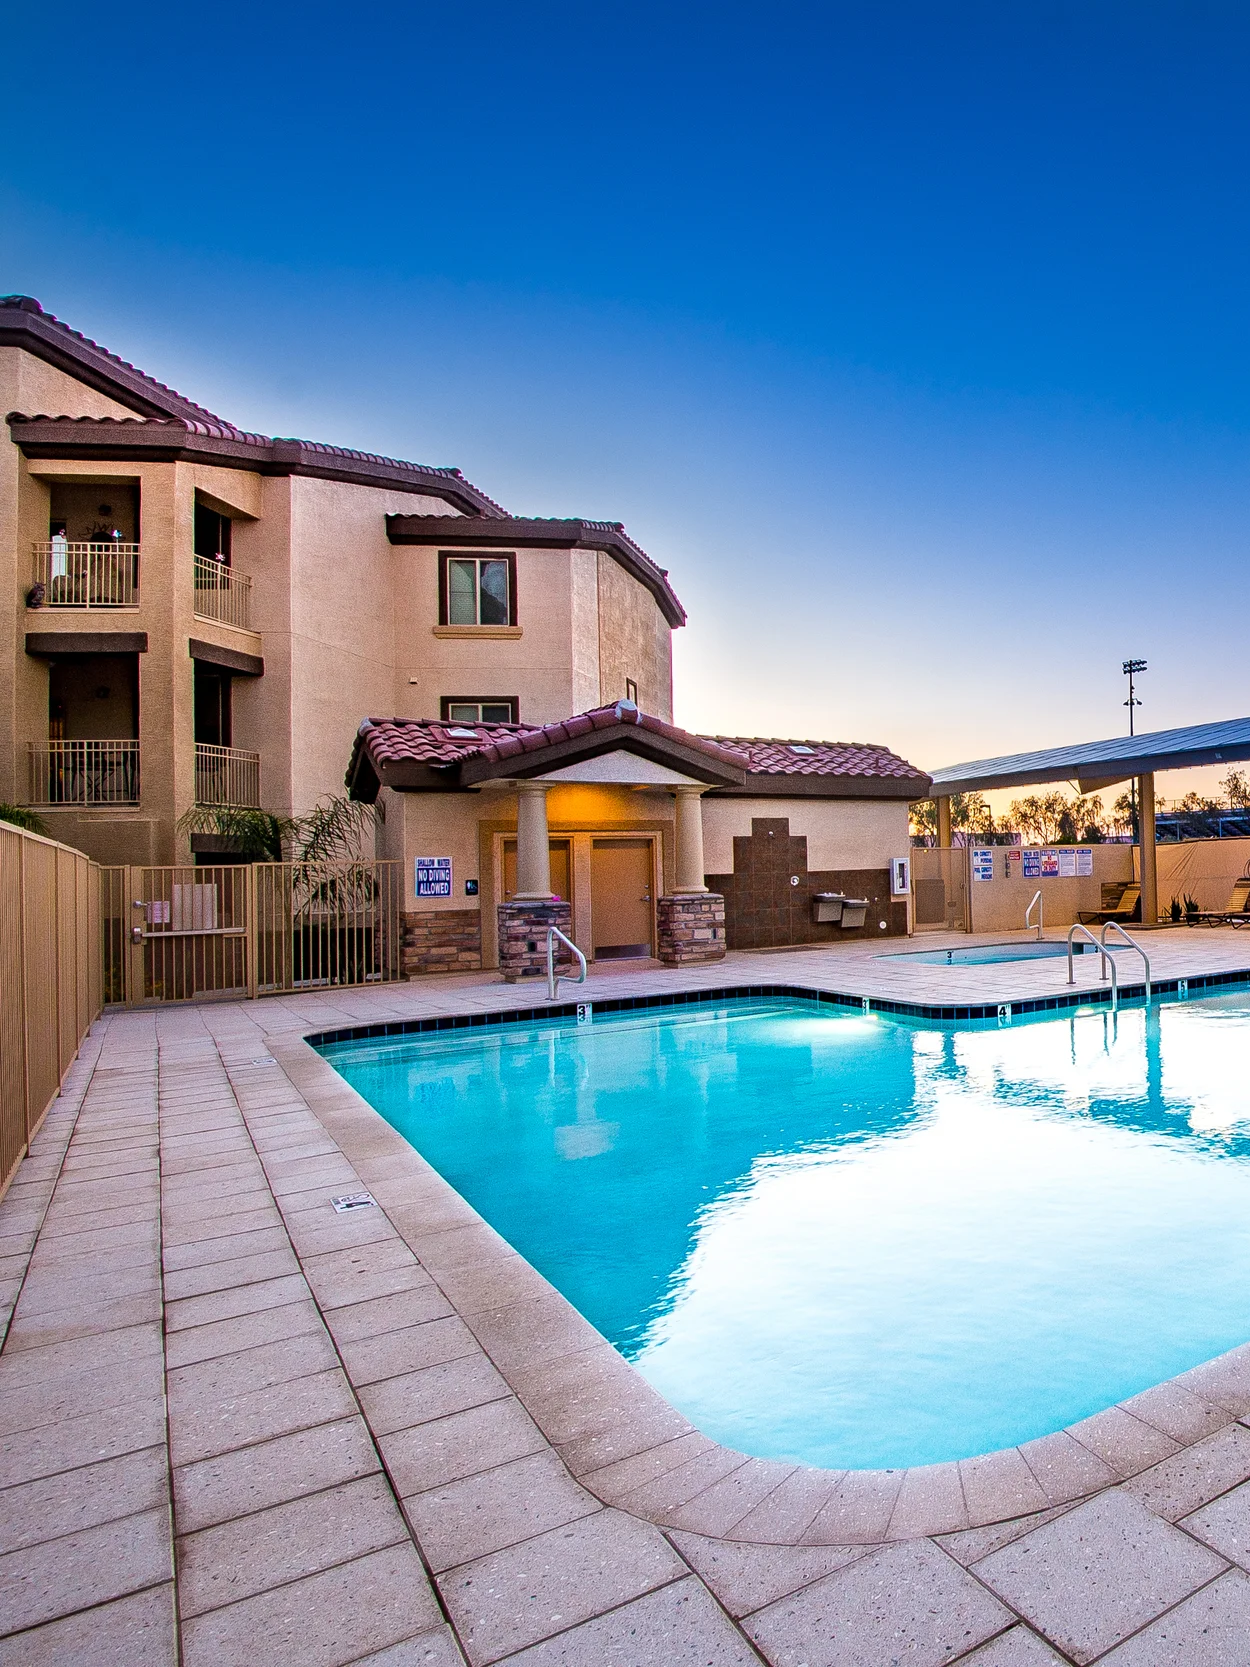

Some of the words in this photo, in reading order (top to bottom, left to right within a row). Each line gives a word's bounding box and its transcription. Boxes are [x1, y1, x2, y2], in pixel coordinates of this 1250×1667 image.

[418, 869, 428, 882] NO
[428, 869, 450, 881] DIVING
[419, 882, 449, 895] ALLOWED
[578, 1005, 586, 1014] 3
[999, 1006, 1006, 1017] 4
